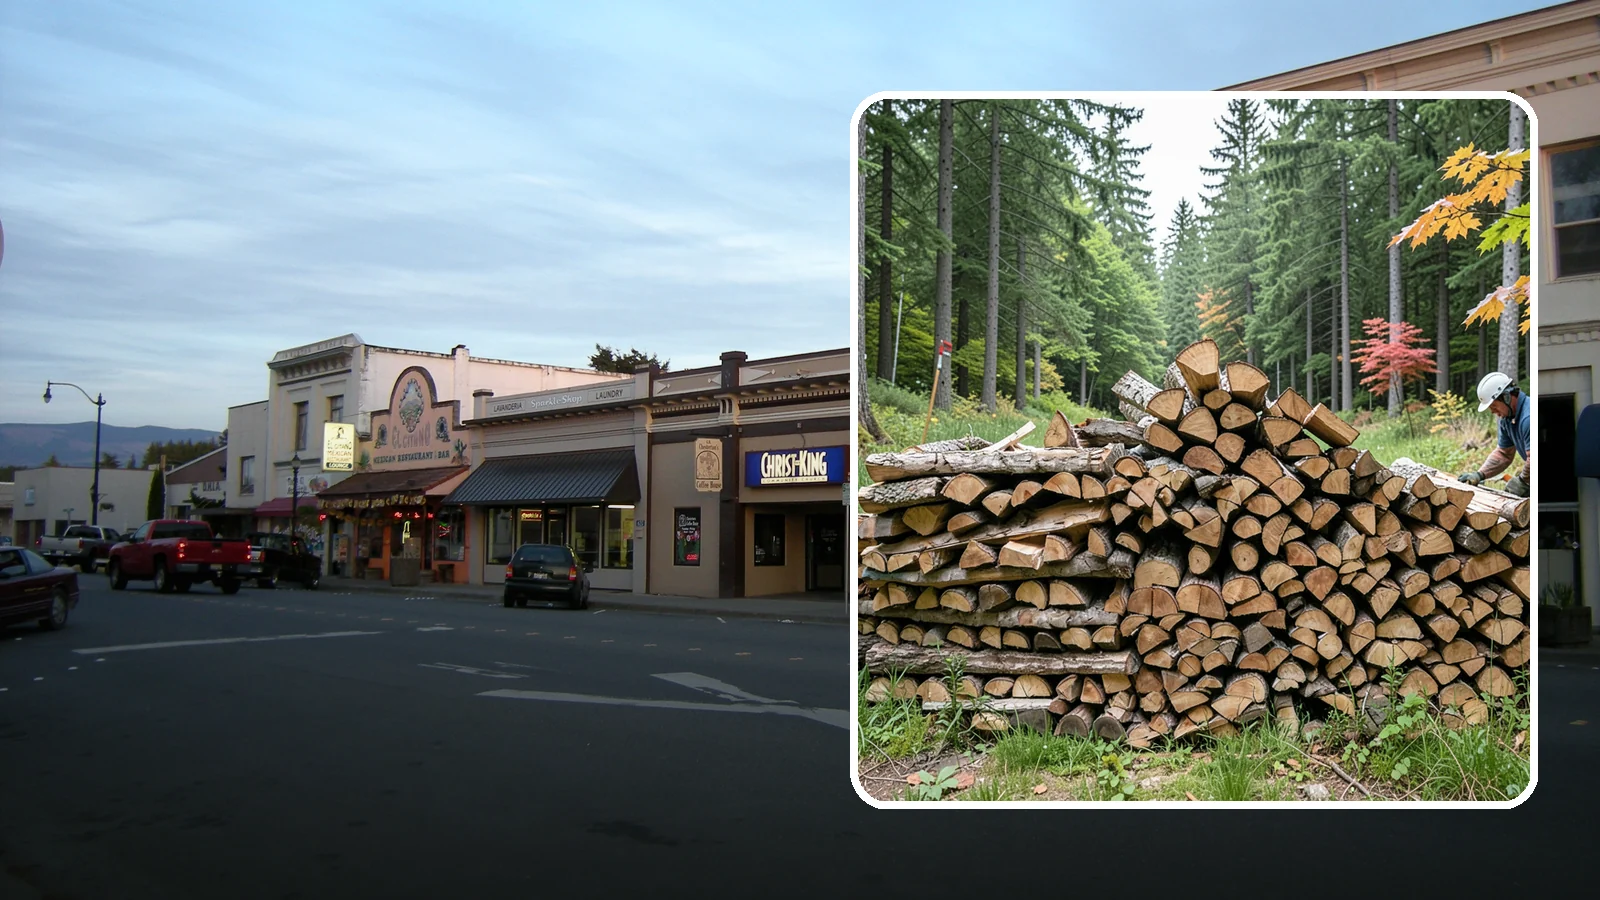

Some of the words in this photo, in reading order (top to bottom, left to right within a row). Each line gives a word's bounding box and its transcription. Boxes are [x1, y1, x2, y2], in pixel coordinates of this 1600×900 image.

[595, 389, 624, 400] LAUNDRY
[531, 397, 561, 409] Sparkle
[562, 394, 582, 405] Shop
[493, 402, 523, 413] LAVANDERIA
[327, 440, 333, 450] EL
[373, 454, 397, 465] MEXICAN
[397, 451, 434, 463] RESTAURANT
[437, 450, 451, 460] BAR
[760, 452, 797, 478] CHRIST
[799, 450, 828, 477] KING
[696, 480, 709, 488] Coffee
[710, 480, 722, 488] House
